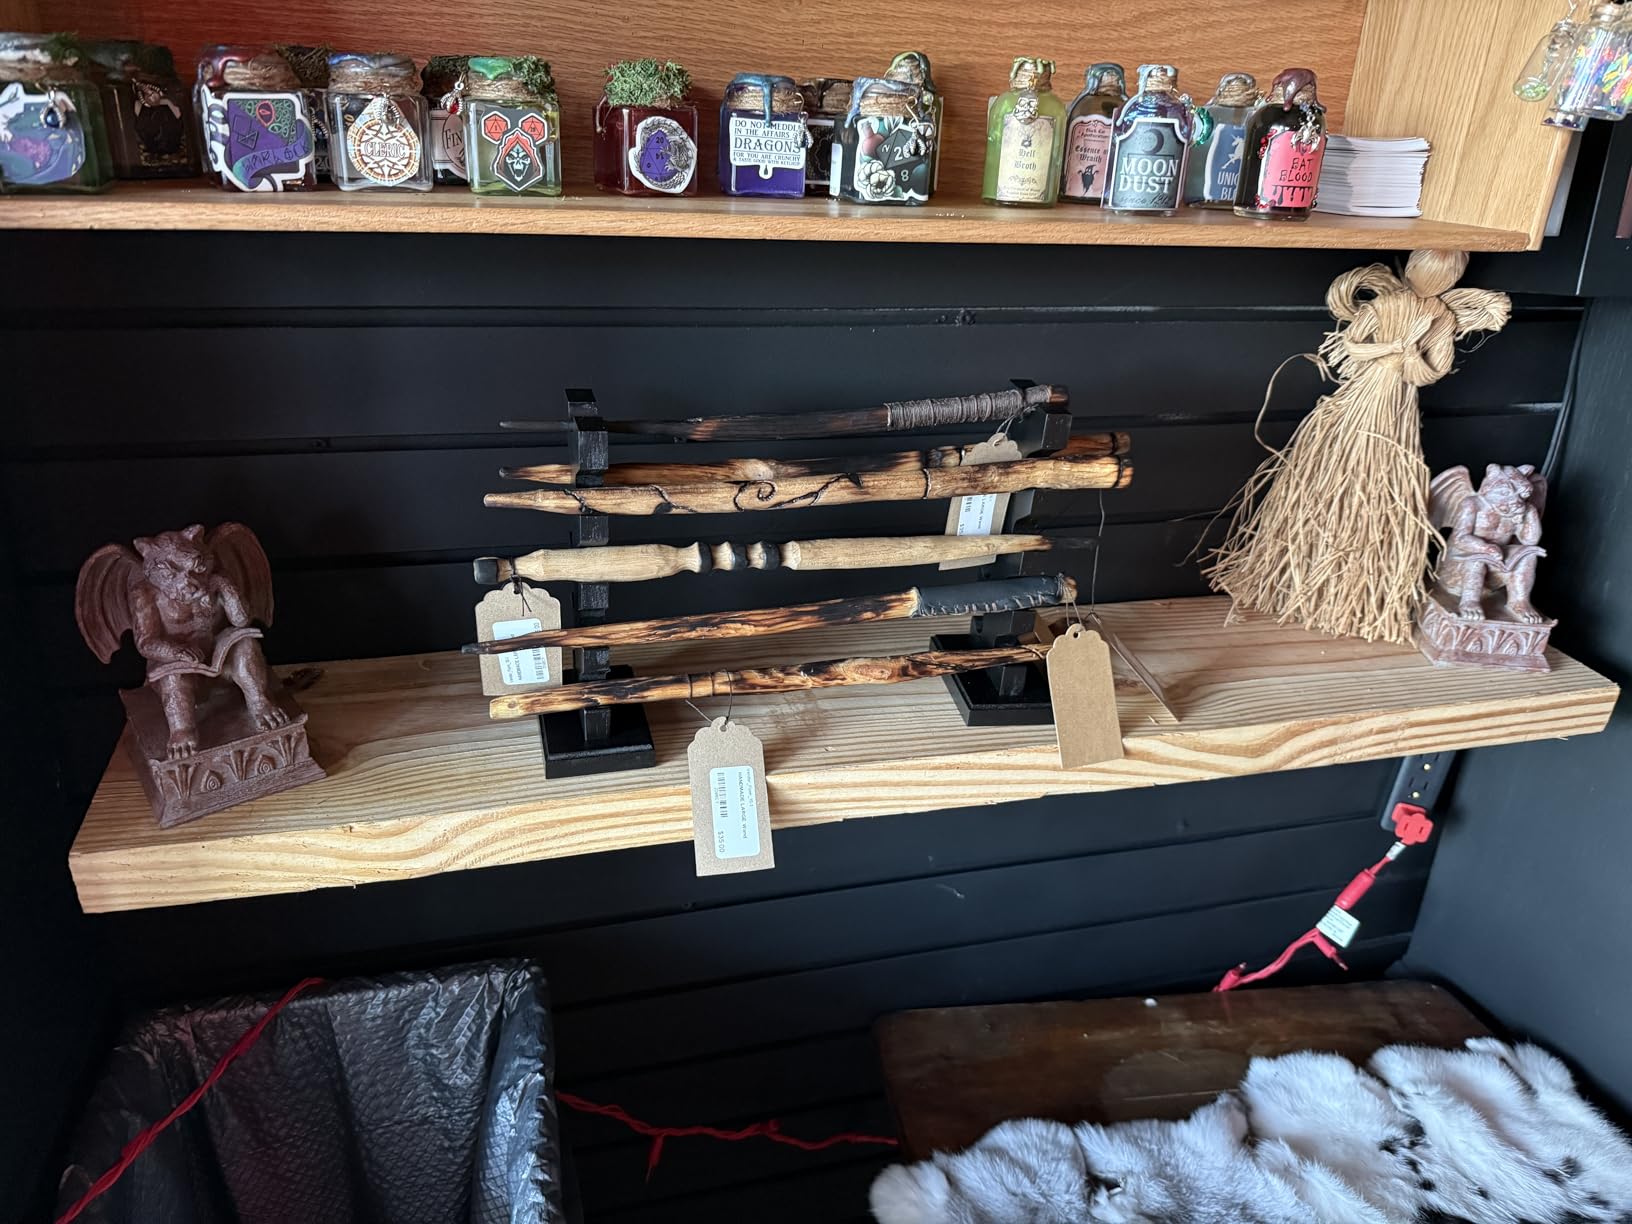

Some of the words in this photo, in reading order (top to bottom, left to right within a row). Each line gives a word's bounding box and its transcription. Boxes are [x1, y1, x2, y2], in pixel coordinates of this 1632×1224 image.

[735, 120, 747, 128] DO
[745, 128, 758, 136] THE
[762, 130, 790, 138] AFFAIRS
[656, 136, 664, 144] 20
[734, 137, 801, 154] DRAGONS
[364, 141, 405, 158] CLERIC
[1018, 149, 1036, 158] Hell
[1013, 160, 1037, 170] Broth
[1120, 157, 1179, 177] MOON
[900, 169, 909, 182] 8
[1279, 170, 1313, 183] BLOOD
[1119, 175, 1174, 194] DUST
[738, 771, 746, 802] HANDMADE
